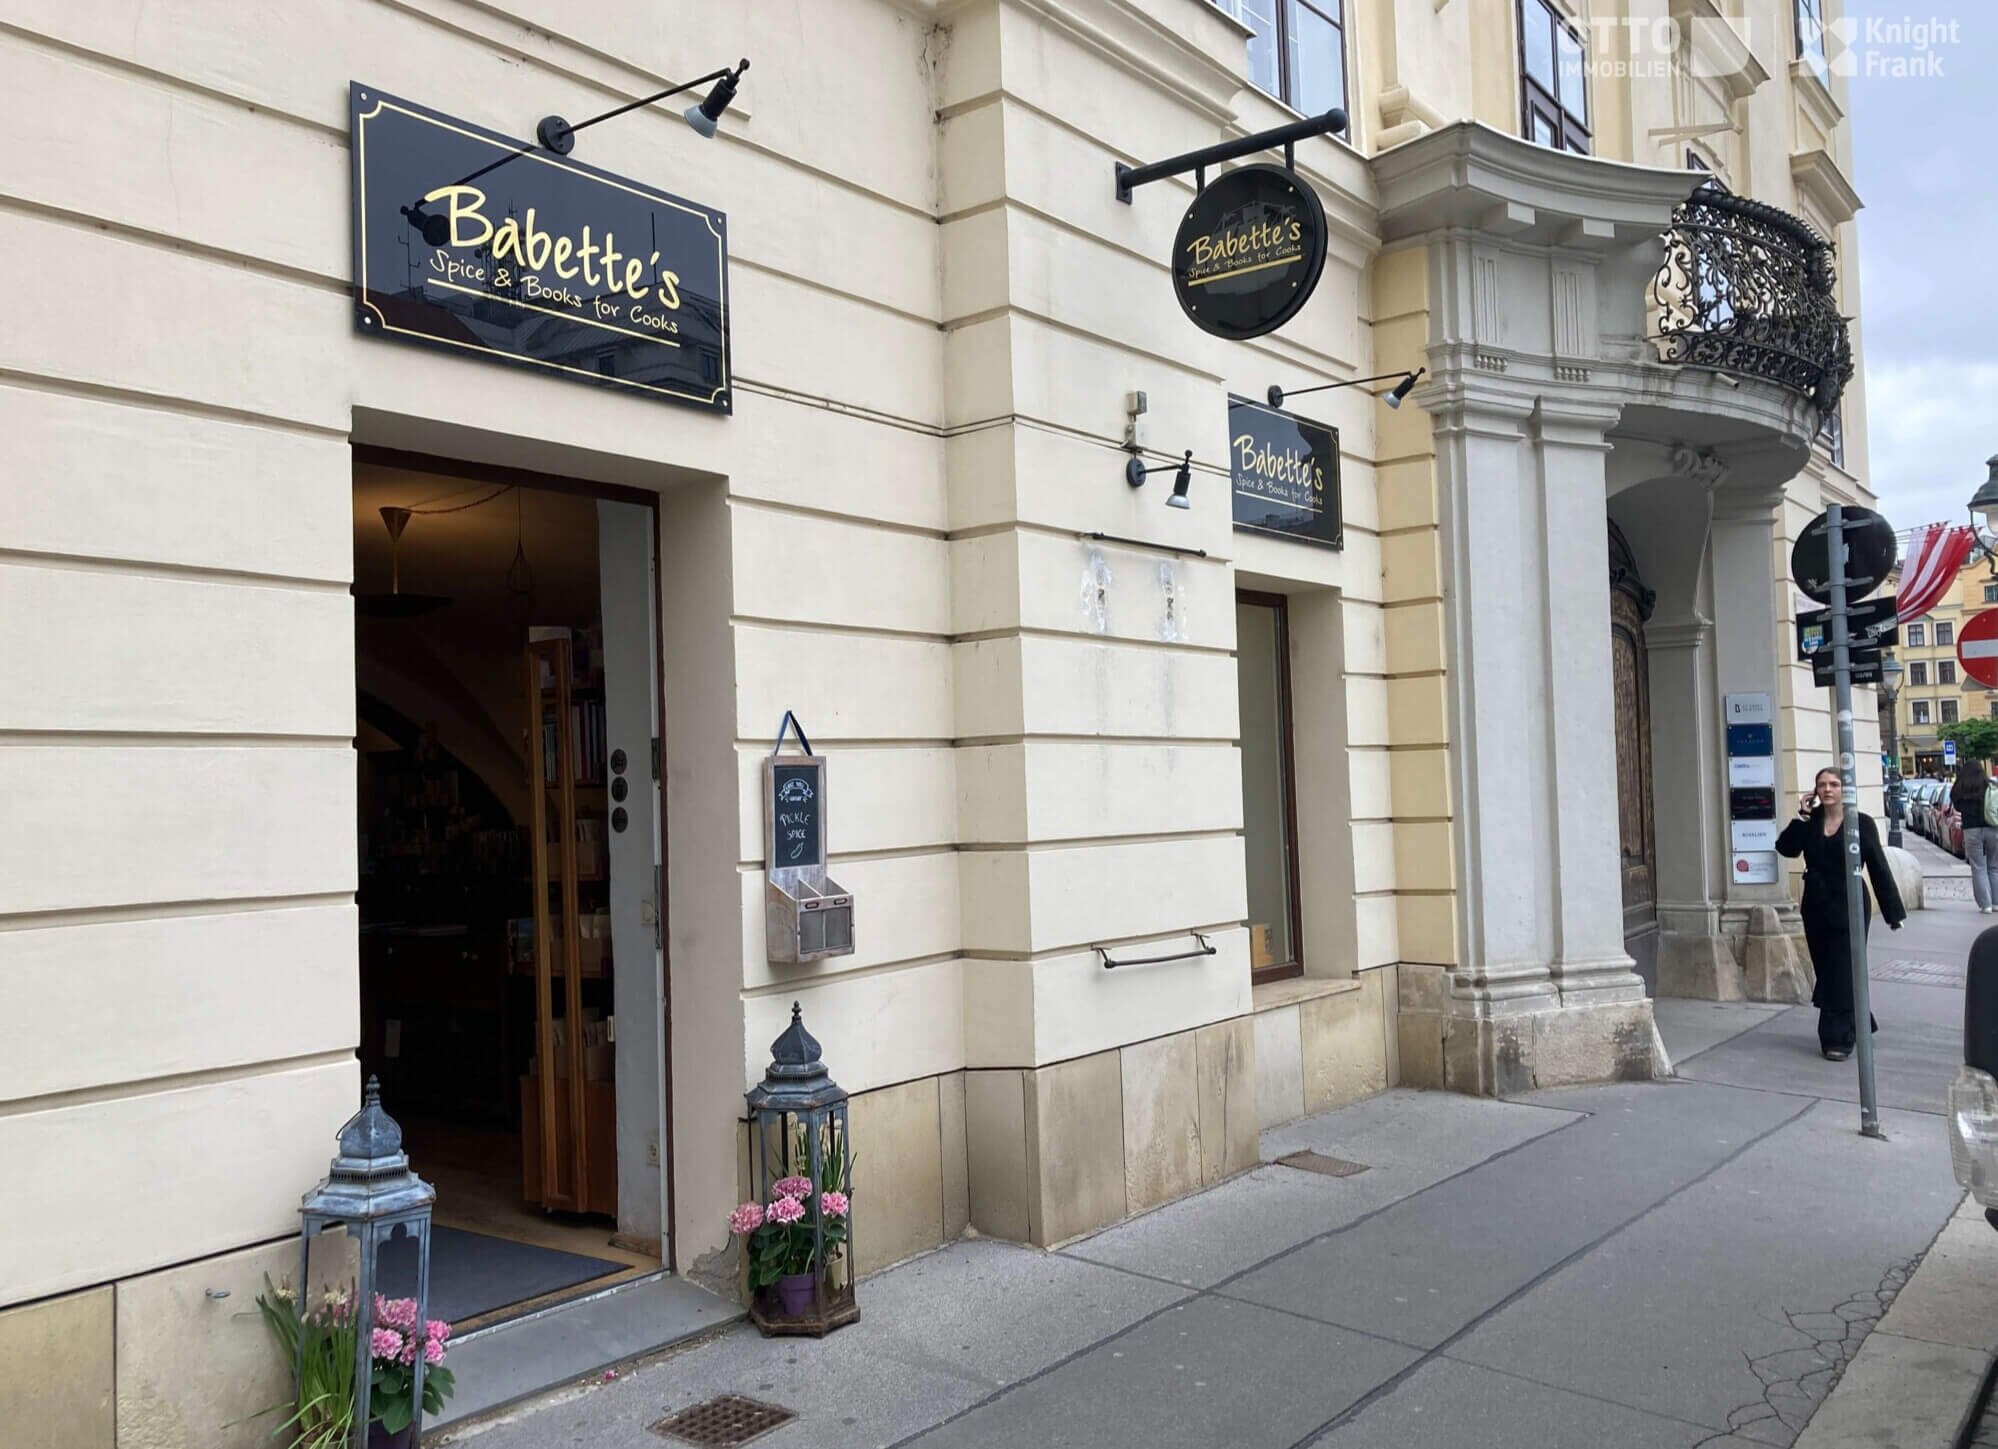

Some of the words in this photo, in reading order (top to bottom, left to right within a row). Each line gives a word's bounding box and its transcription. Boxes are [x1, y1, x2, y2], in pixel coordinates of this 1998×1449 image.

[424, 185, 680, 310] Babette's
[1186, 216, 1302, 264] Babette's
[1189, 267, 1210, 279] Spice
[1224, 256, 1252, 268] Books
[1257, 251, 1270, 262] for
[1276, 244, 1301, 256] Cooks
[430, 249, 485, 282] Spice
[493, 268, 512, 287] &
[520, 275, 583, 308] Books
[593, 296, 620, 319] for
[630, 306, 679, 334] Cooks
[1233, 434, 1323, 491] Babette's
[1236, 472, 1255, 490] Spice
[1257, 478, 1264, 490] &
[1266, 481, 1289, 496] Books
[1304, 490, 1323, 504] Cooks
